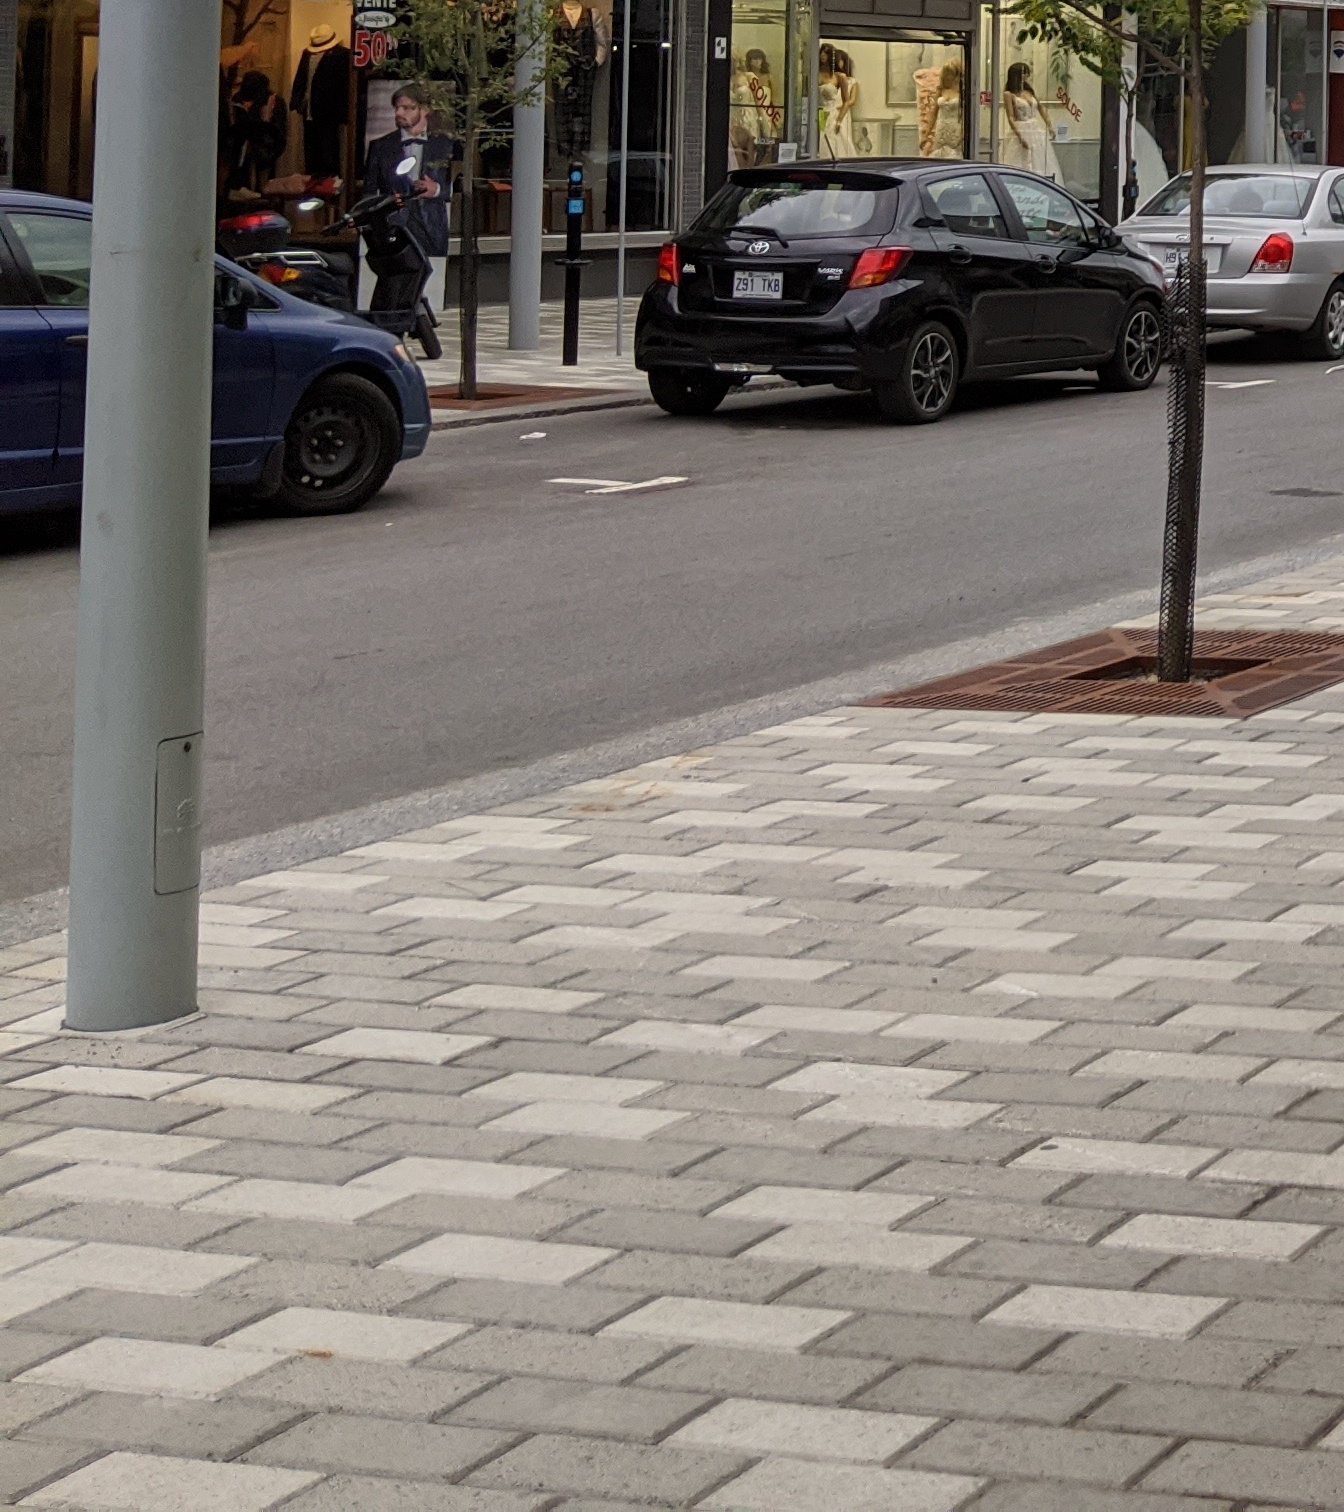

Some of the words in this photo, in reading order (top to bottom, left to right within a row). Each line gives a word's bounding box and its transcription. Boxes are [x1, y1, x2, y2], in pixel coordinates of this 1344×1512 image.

[749, 77, 782, 128] SOLDE
[1056, 86, 1083, 123] SOLDE
[735, 277, 755, 292] Z91
[761, 278, 781, 292] TKB
